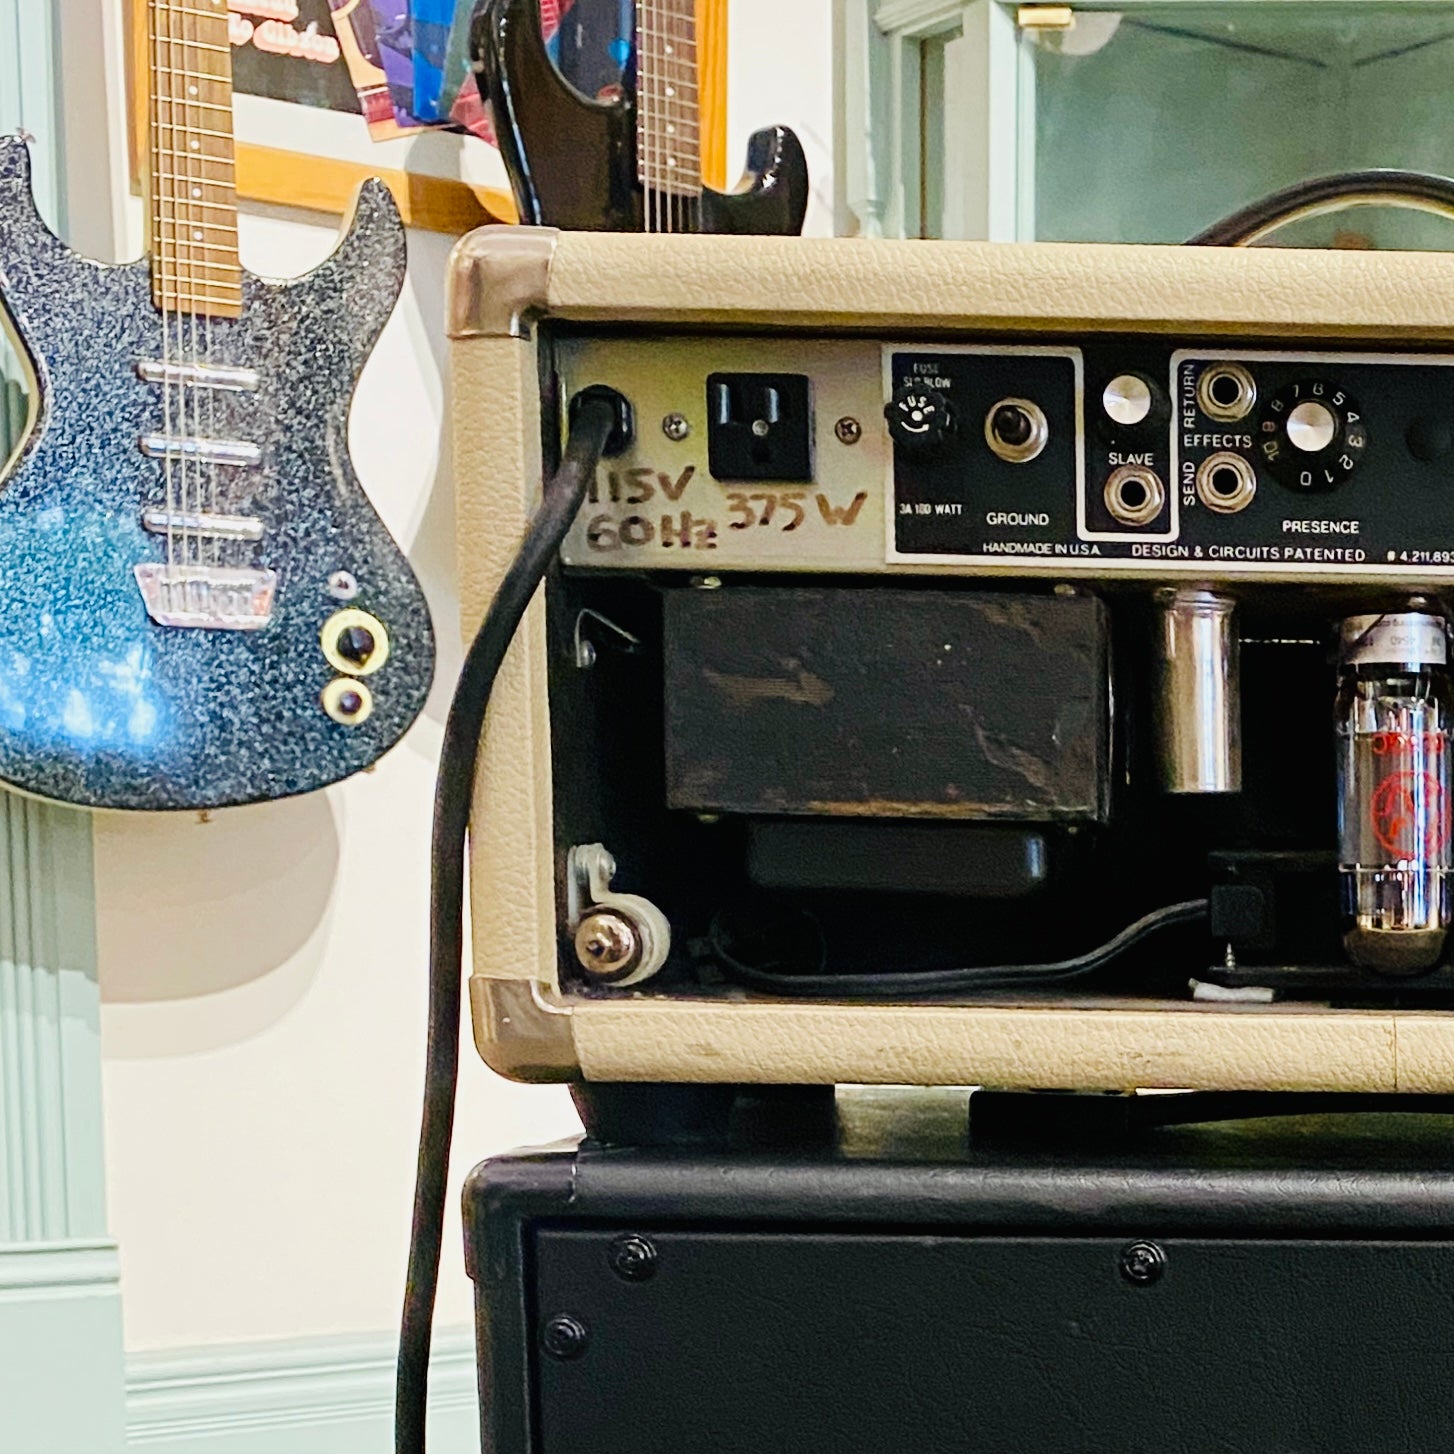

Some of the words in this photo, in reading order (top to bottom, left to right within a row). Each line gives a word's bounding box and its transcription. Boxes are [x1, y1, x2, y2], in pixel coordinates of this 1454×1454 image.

[1183, 364, 1196, 428] RETURN
[1332, 391, 1346, 406] 5
[899, 395, 935, 415] FUSE
[1347, 411, 1360, 423] 4
[1184, 434, 1252, 448] EFFECTS
[1348, 434, 1363, 448] 3
[1108, 452, 1154, 466] SLAVE
[1338, 454, 1354, 470] 2
[1182, 461, 1196, 506] SEND
[726, 491, 806, 531] 375
[815, 491, 868, 526] W
[934, 504, 963, 516] WATT
[986, 512, 1050, 526] GROUND
[1282, 519, 1360, 534] PRESENCE
[587, 509, 718, 551] 60Hz
[983, 542, 1052, 554] HANDMADE
[1054, 544, 1067, 555] IN
[1132, 544, 1189, 558] DESIGN
[1194, 546, 1203, 558] &
[1208, 545, 1280, 560] CIRCUITS
[1284, 547, 1366, 562] PATENTED
